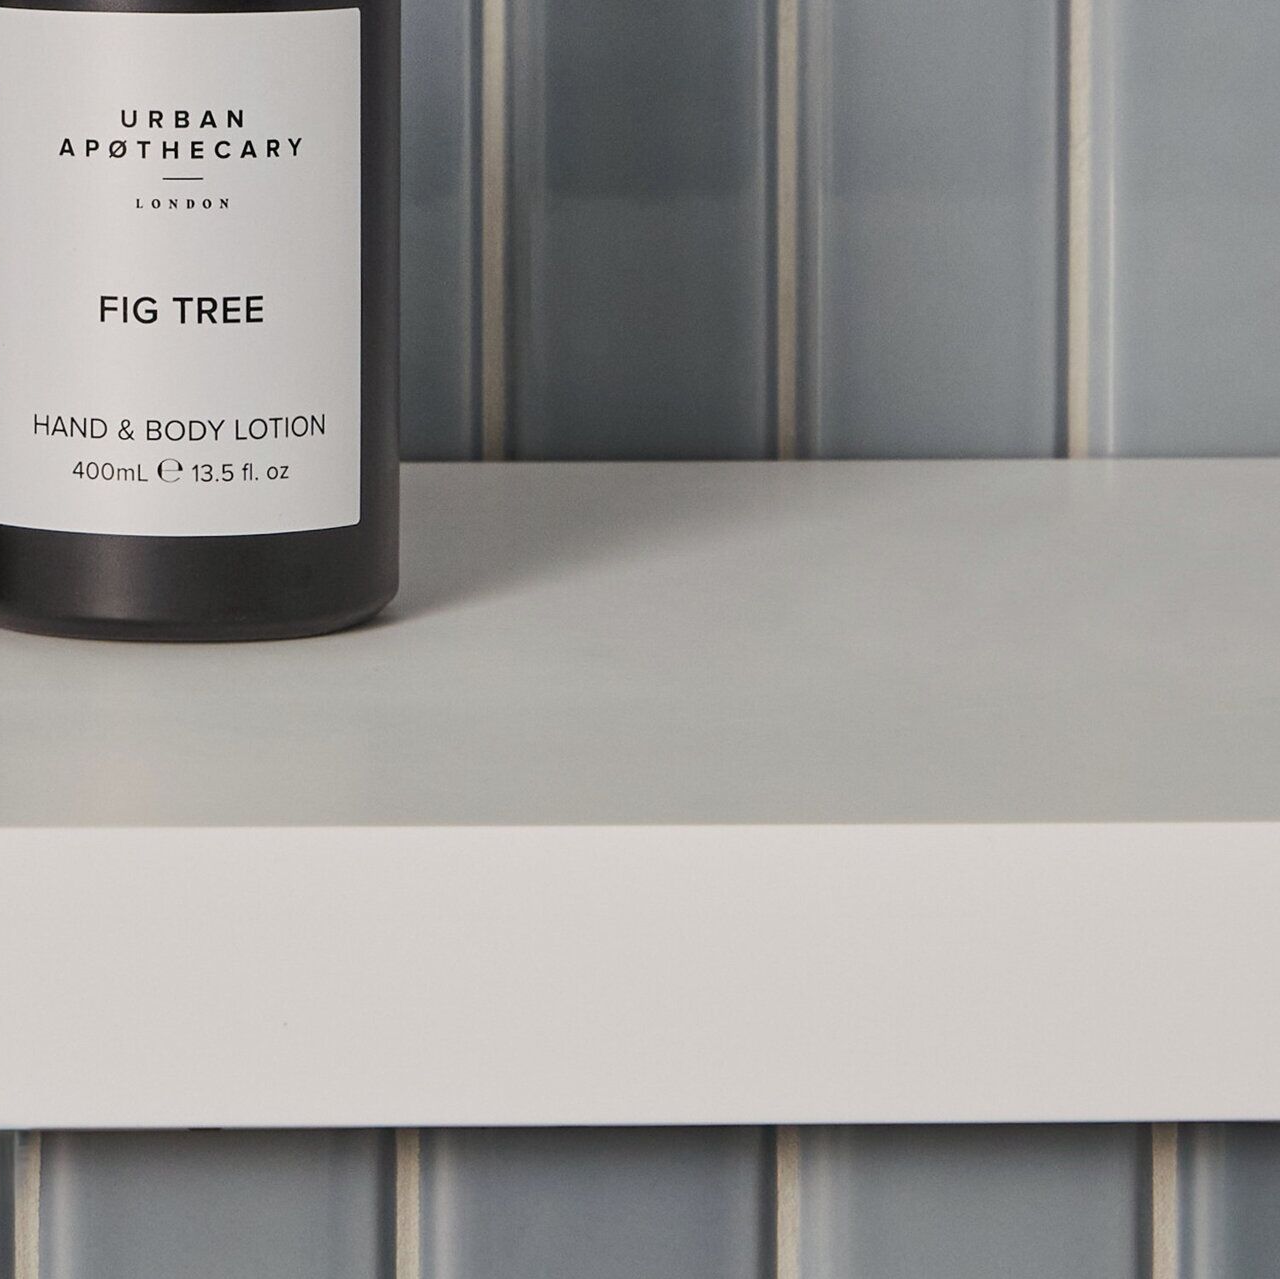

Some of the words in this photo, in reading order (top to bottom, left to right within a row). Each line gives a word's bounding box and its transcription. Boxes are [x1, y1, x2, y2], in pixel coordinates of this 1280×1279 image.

[120, 108, 244, 129] URBAN
[58, 137, 303, 160] APØTHECARY
[135, 197, 230, 210] LONDON
[99, 295, 158, 325] FIG
[171, 294, 264, 325] TREE
[33, 413, 108, 440] HAND
[117, 418, 135, 441] &
[146, 419, 226, 442] BODY
[234, 413, 326, 441] LOTION
[72, 460, 149, 483] 400mL
[191, 463, 235, 483] 13.5
[241, 462, 259, 482] fl.
[266, 465, 290, 481] oz
